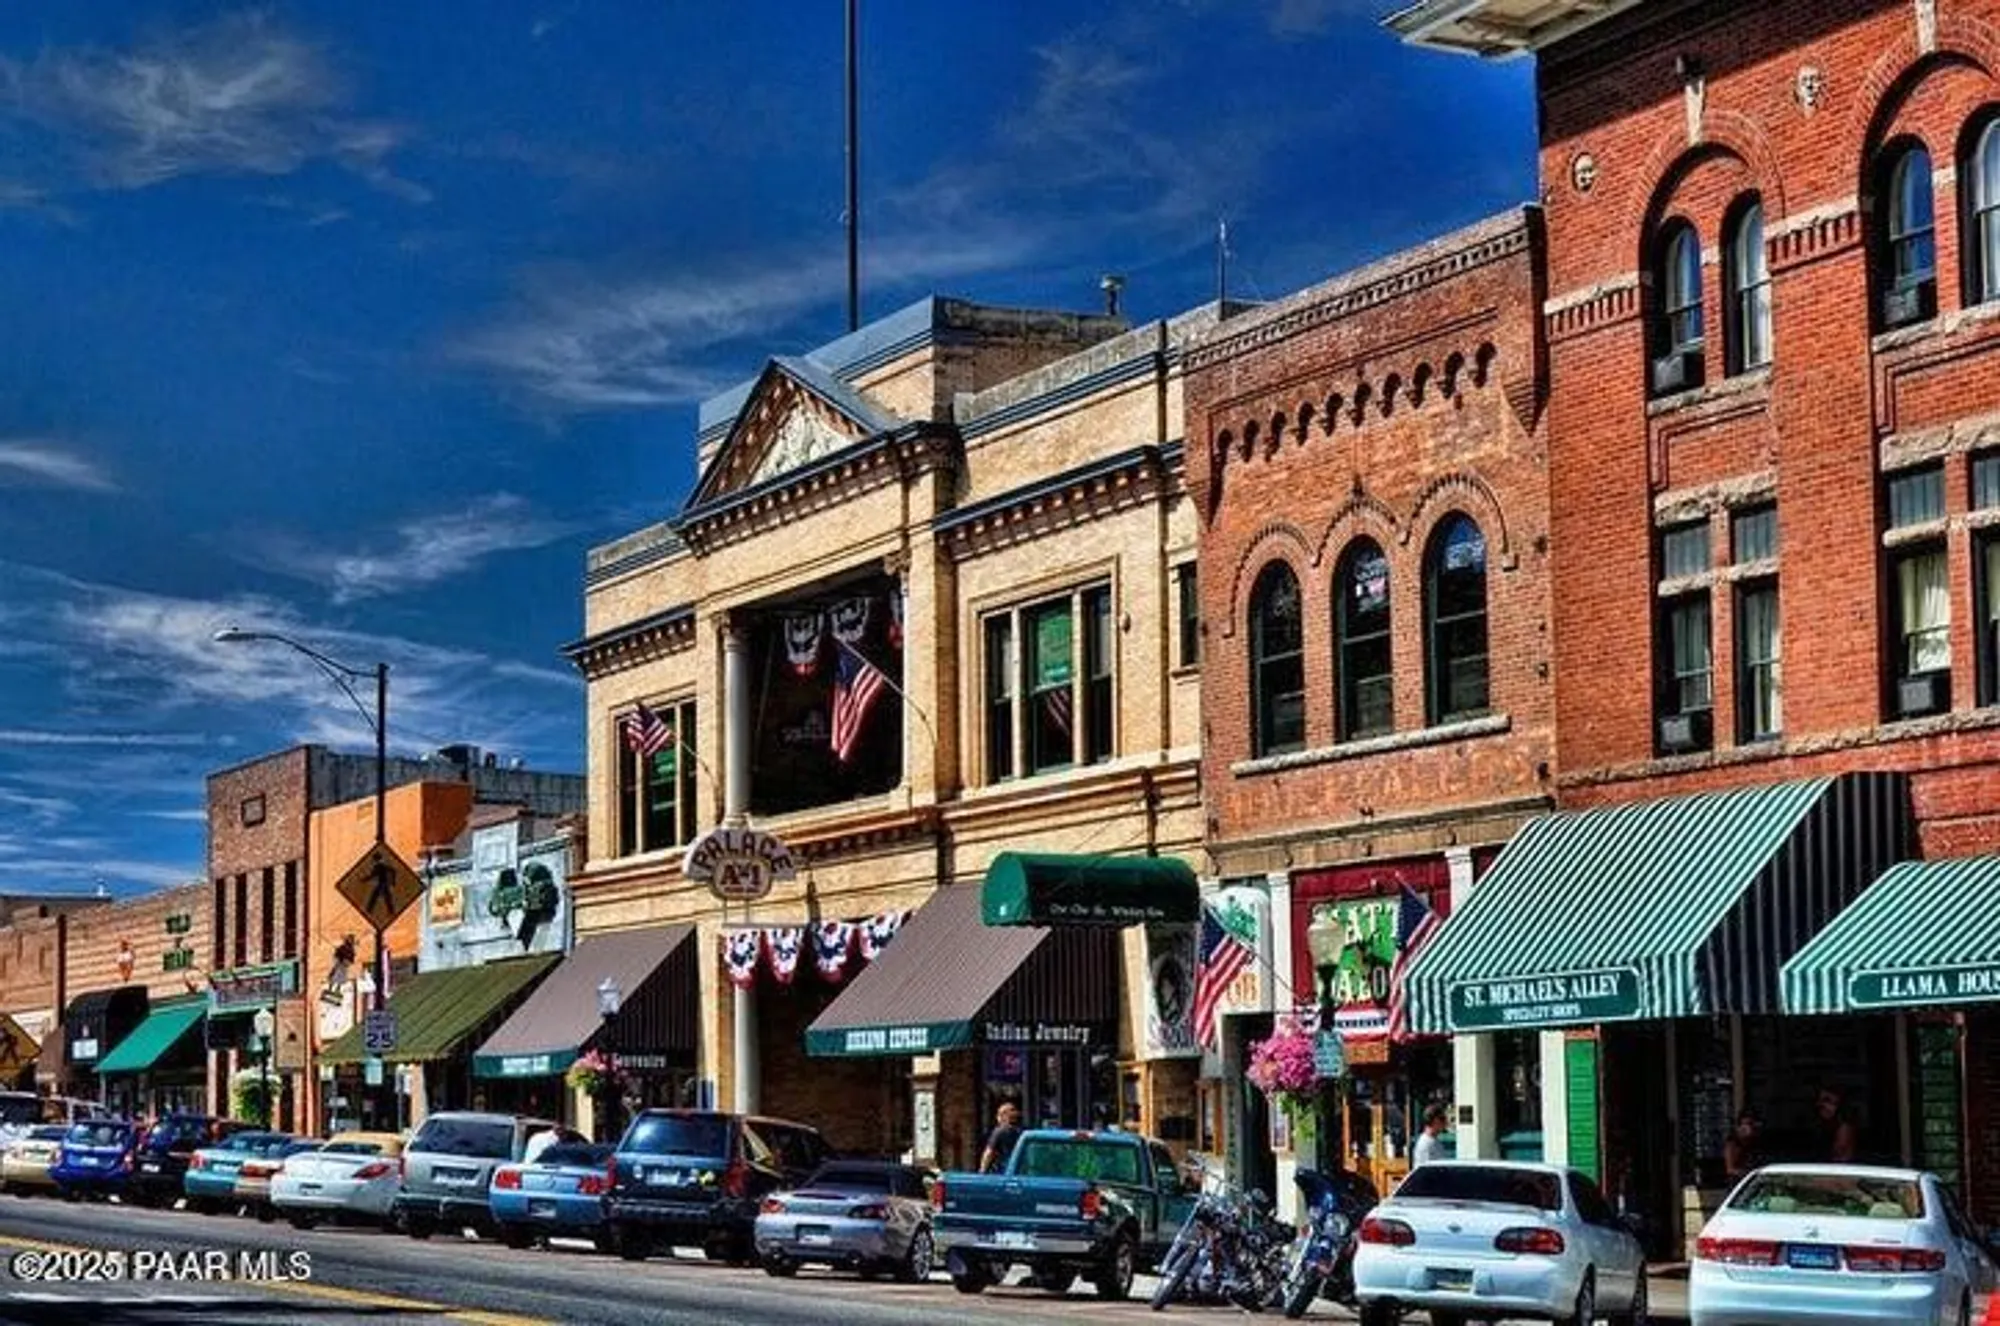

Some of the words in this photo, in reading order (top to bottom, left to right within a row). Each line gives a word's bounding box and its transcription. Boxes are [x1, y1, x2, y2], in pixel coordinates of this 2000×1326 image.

[691, 831, 793, 873] PALACE
[1464, 986, 1486, 1008] ST.
[1569, 973, 1620, 999] ALLEY
[1881, 975, 1947, 998] LLAMA
[986, 1022, 1029, 1040] Indian
